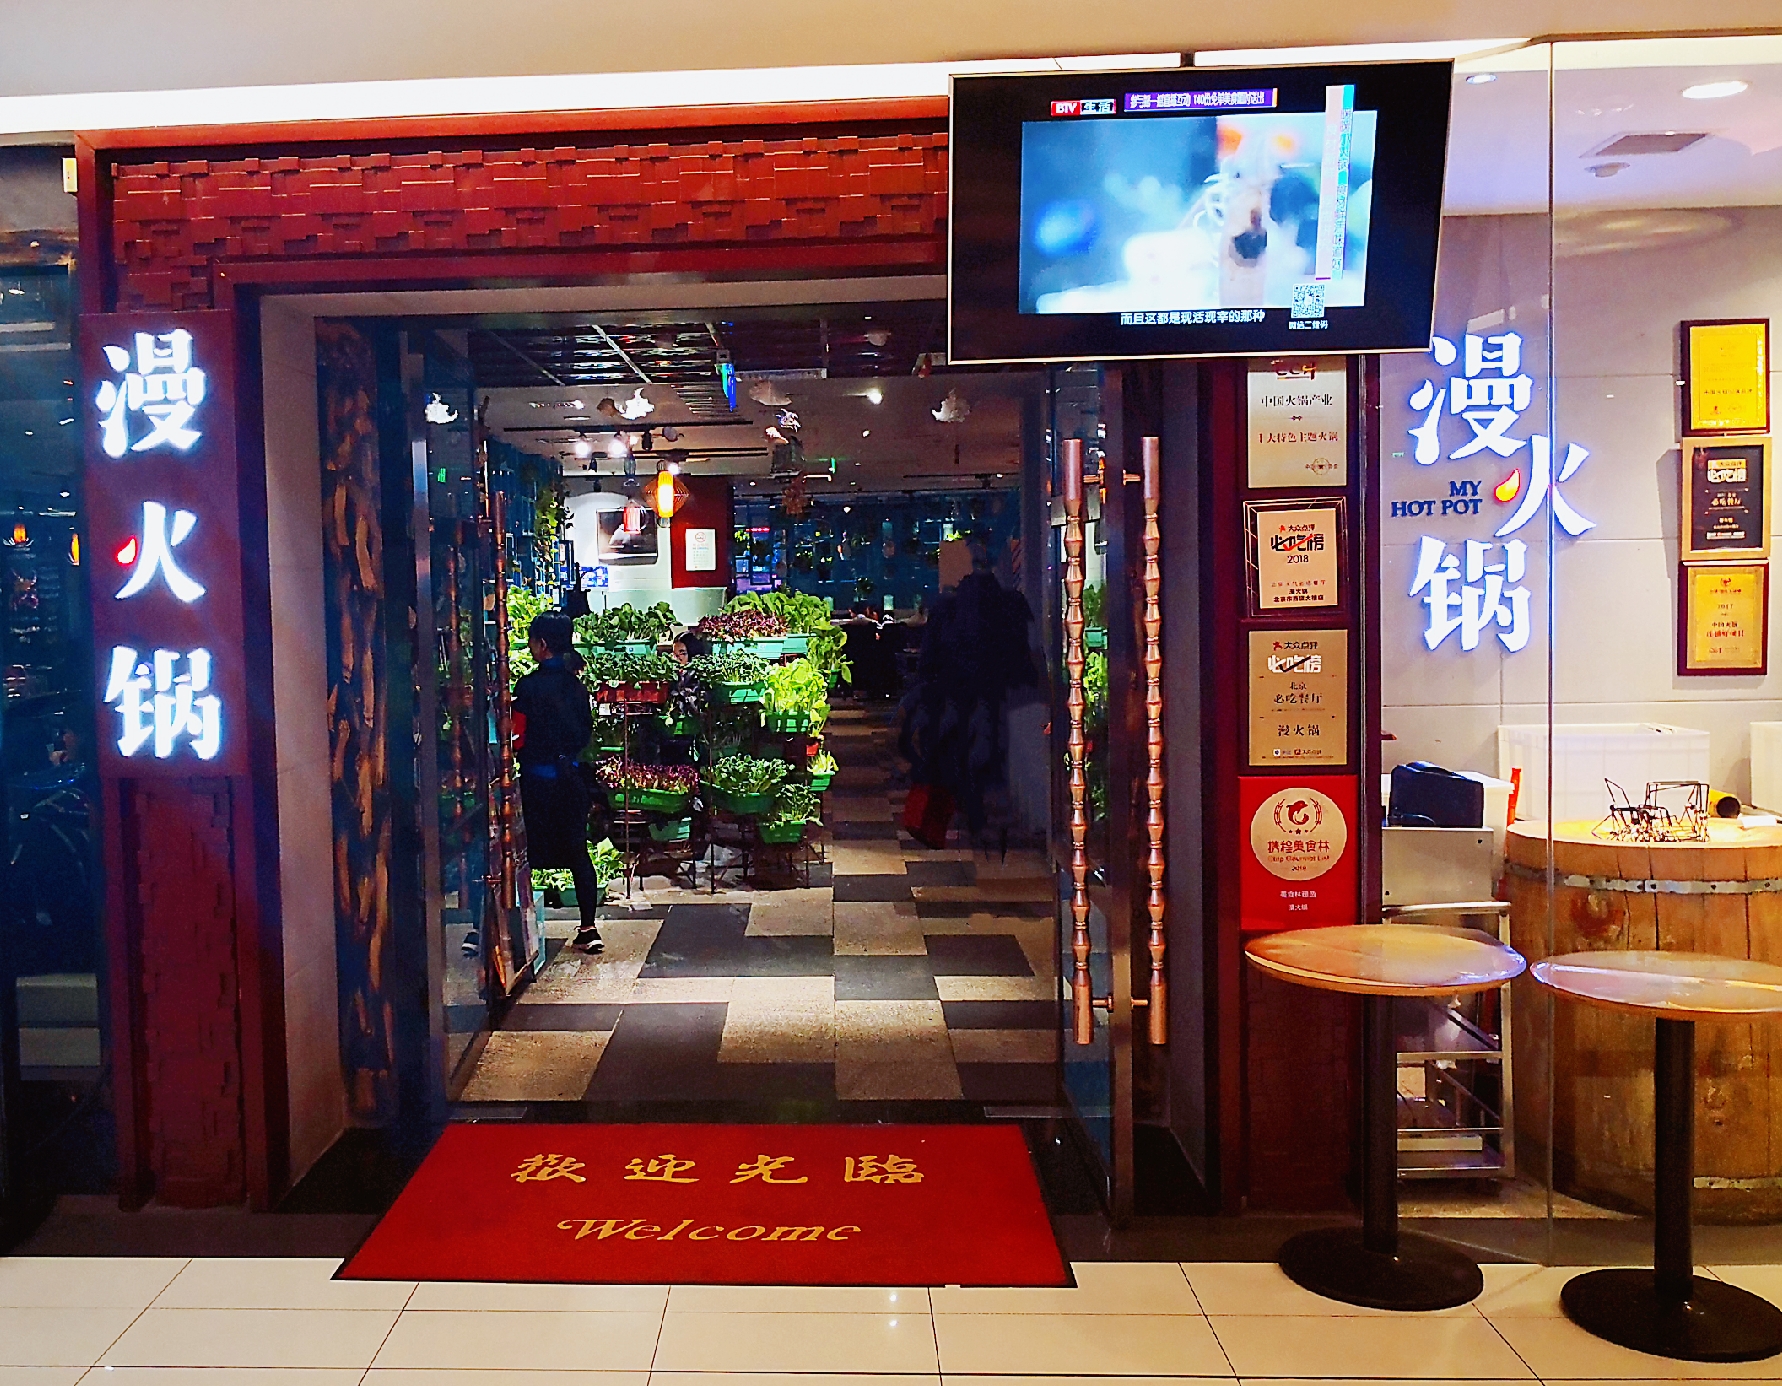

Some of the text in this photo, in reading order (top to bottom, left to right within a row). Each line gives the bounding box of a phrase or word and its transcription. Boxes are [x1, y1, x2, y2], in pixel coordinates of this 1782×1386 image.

[1055, 101, 1113, 114] BTV 生活
[1261, 394, 1334, 408] 中国火锅产业
[1257, 431, 1339, 444] 十大特色主题火锅
[1408, 331, 1597, 653] 漫火锅
[1448, 480, 1482, 497] MY
[1391, 499, 1483, 517] HOT POT
[1288, 523, 1316, 532] 大众点评
[95, 328, 222, 761] 漫火锅
[1287, 554, 1309, 564] 2018
[1284, 641, 1318, 650] 大众点评
[1267, 655, 1322, 673] 必吃榜
[1289, 681, 1307, 691] 北京
[1273, 692, 1323, 704] 必吃餐厅
[1278, 723, 1321, 737] 漫火锅
[557, 1219, 862, 1241] Welcome
